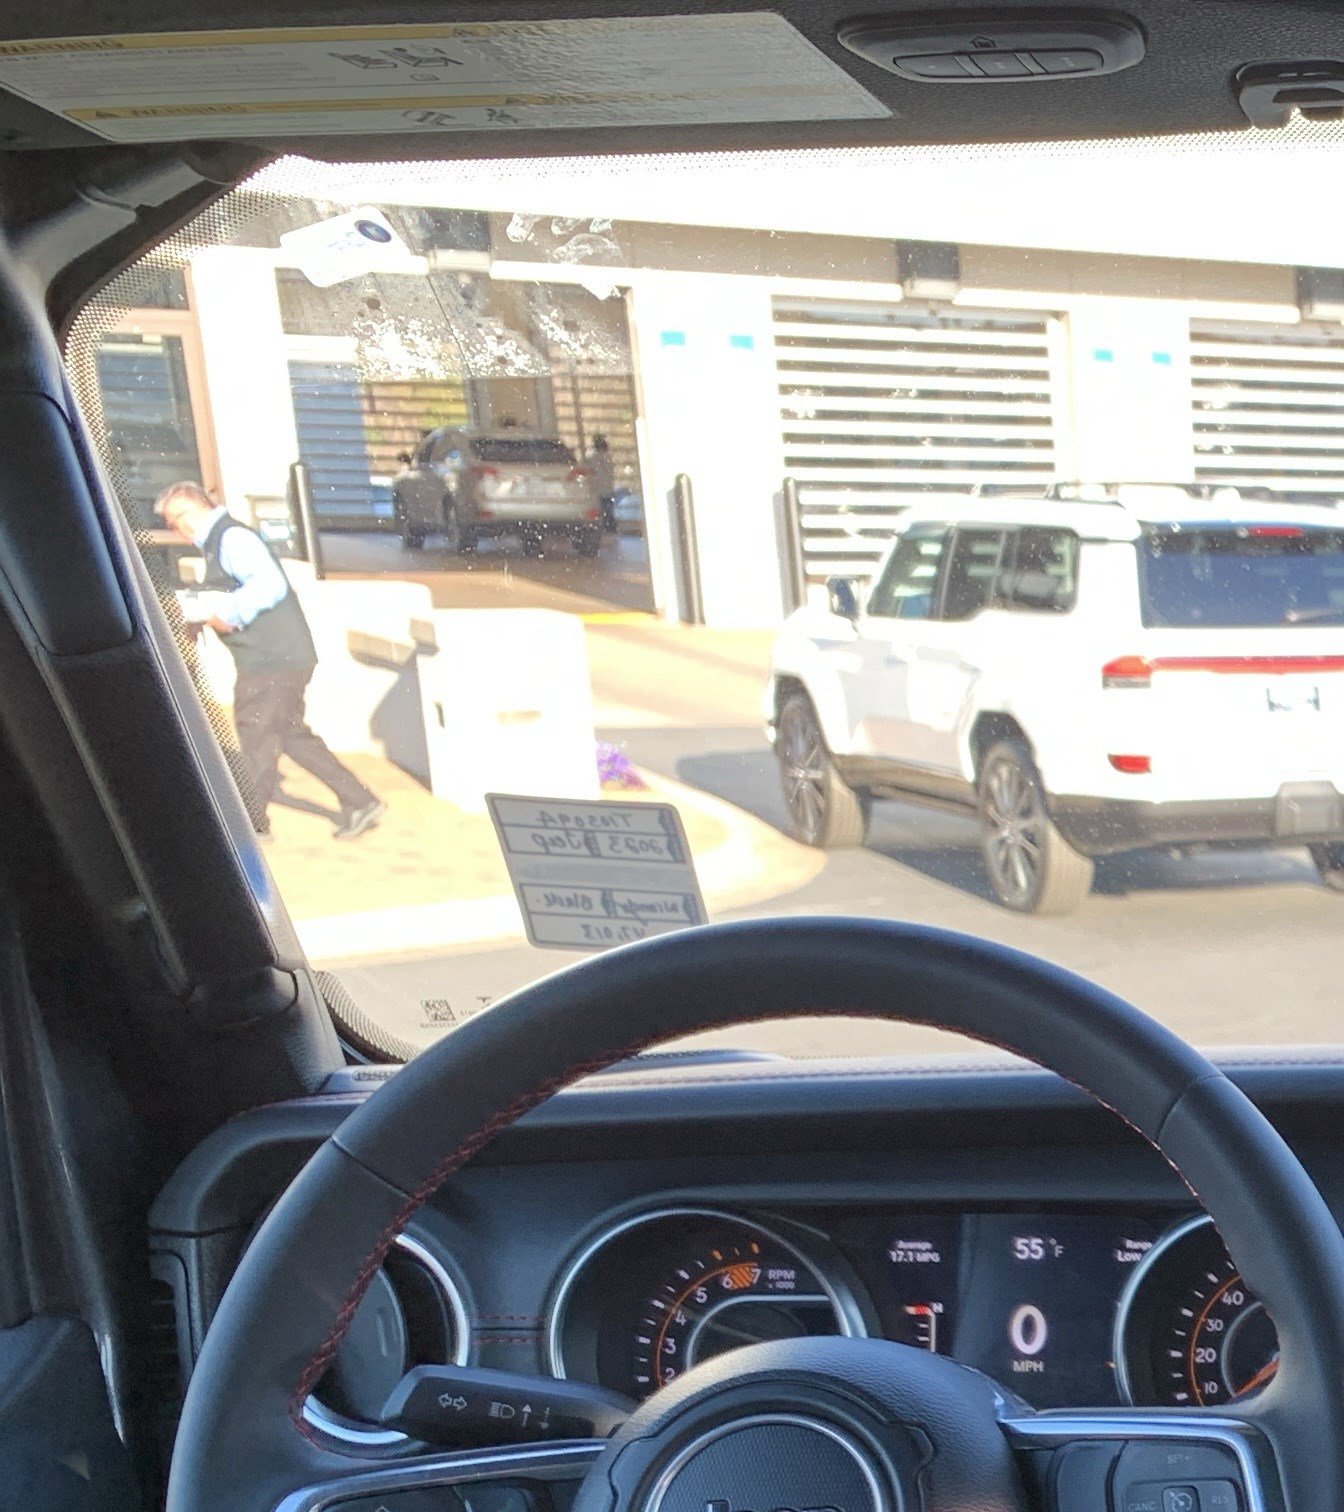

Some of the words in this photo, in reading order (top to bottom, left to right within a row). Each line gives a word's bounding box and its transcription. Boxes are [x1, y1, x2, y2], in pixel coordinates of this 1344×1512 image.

[721, 1273, 734, 1290] 6
[751, 1268, 762, 1285] 7
[767, 1269, 796, 1280] RPM
[696, 1286, 708, 1304] 5
[1221, 1290, 1245, 1307] 40
[674, 1309, 687, 1326] 4
[1204, 1318, 1224, 1334] 30
[1010, 1303, 1048, 1355] 0
[663, 1337, 677, 1355] 3
[1193, 1346, 1217, 1364] 20
[1012, 1360, 1045, 1374] MPH
[1204, 1381, 1219, 1395] 10
